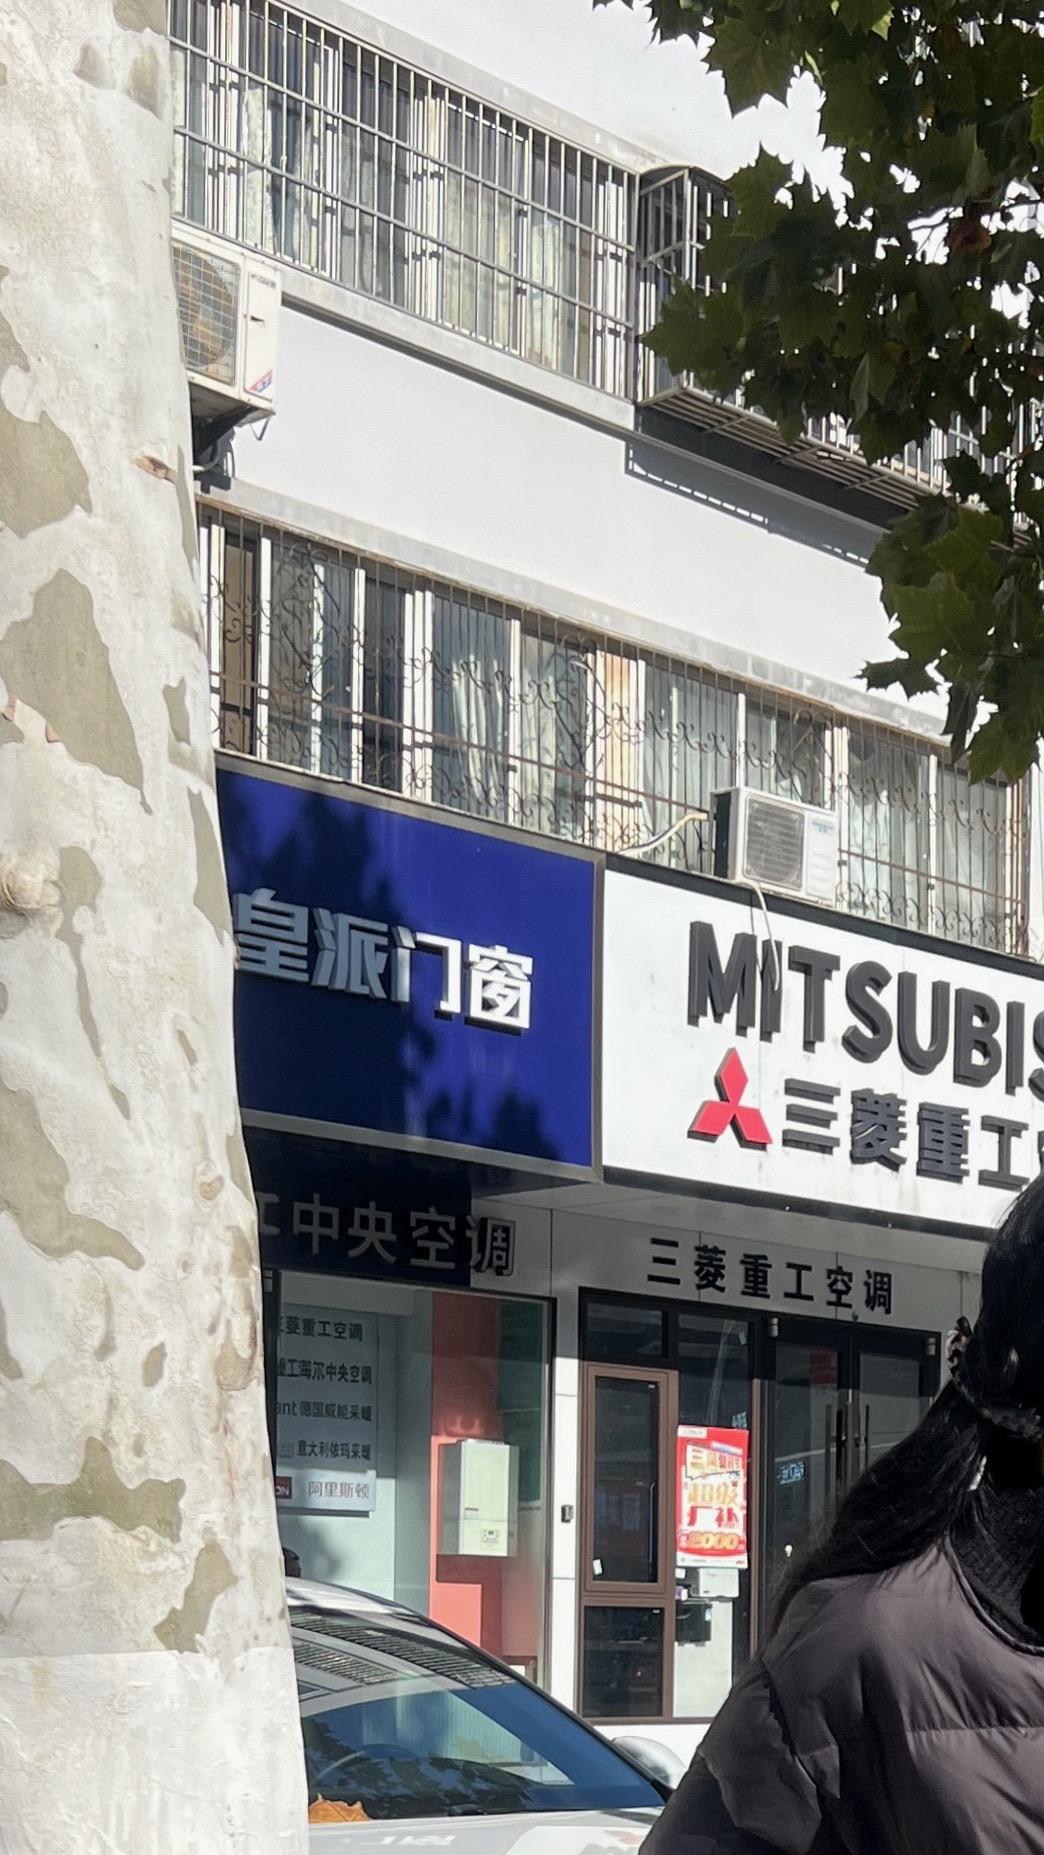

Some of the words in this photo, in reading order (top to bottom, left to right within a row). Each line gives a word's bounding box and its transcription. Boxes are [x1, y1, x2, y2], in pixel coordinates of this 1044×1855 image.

[233, 887, 534, 1030] 皇派门窗
[647, 1237, 893, 1315] 三菱重工空调
[279, 1315, 364, 1342] 菱重工空调
[308, 1480, 370, 1499] 阿里斯顿
